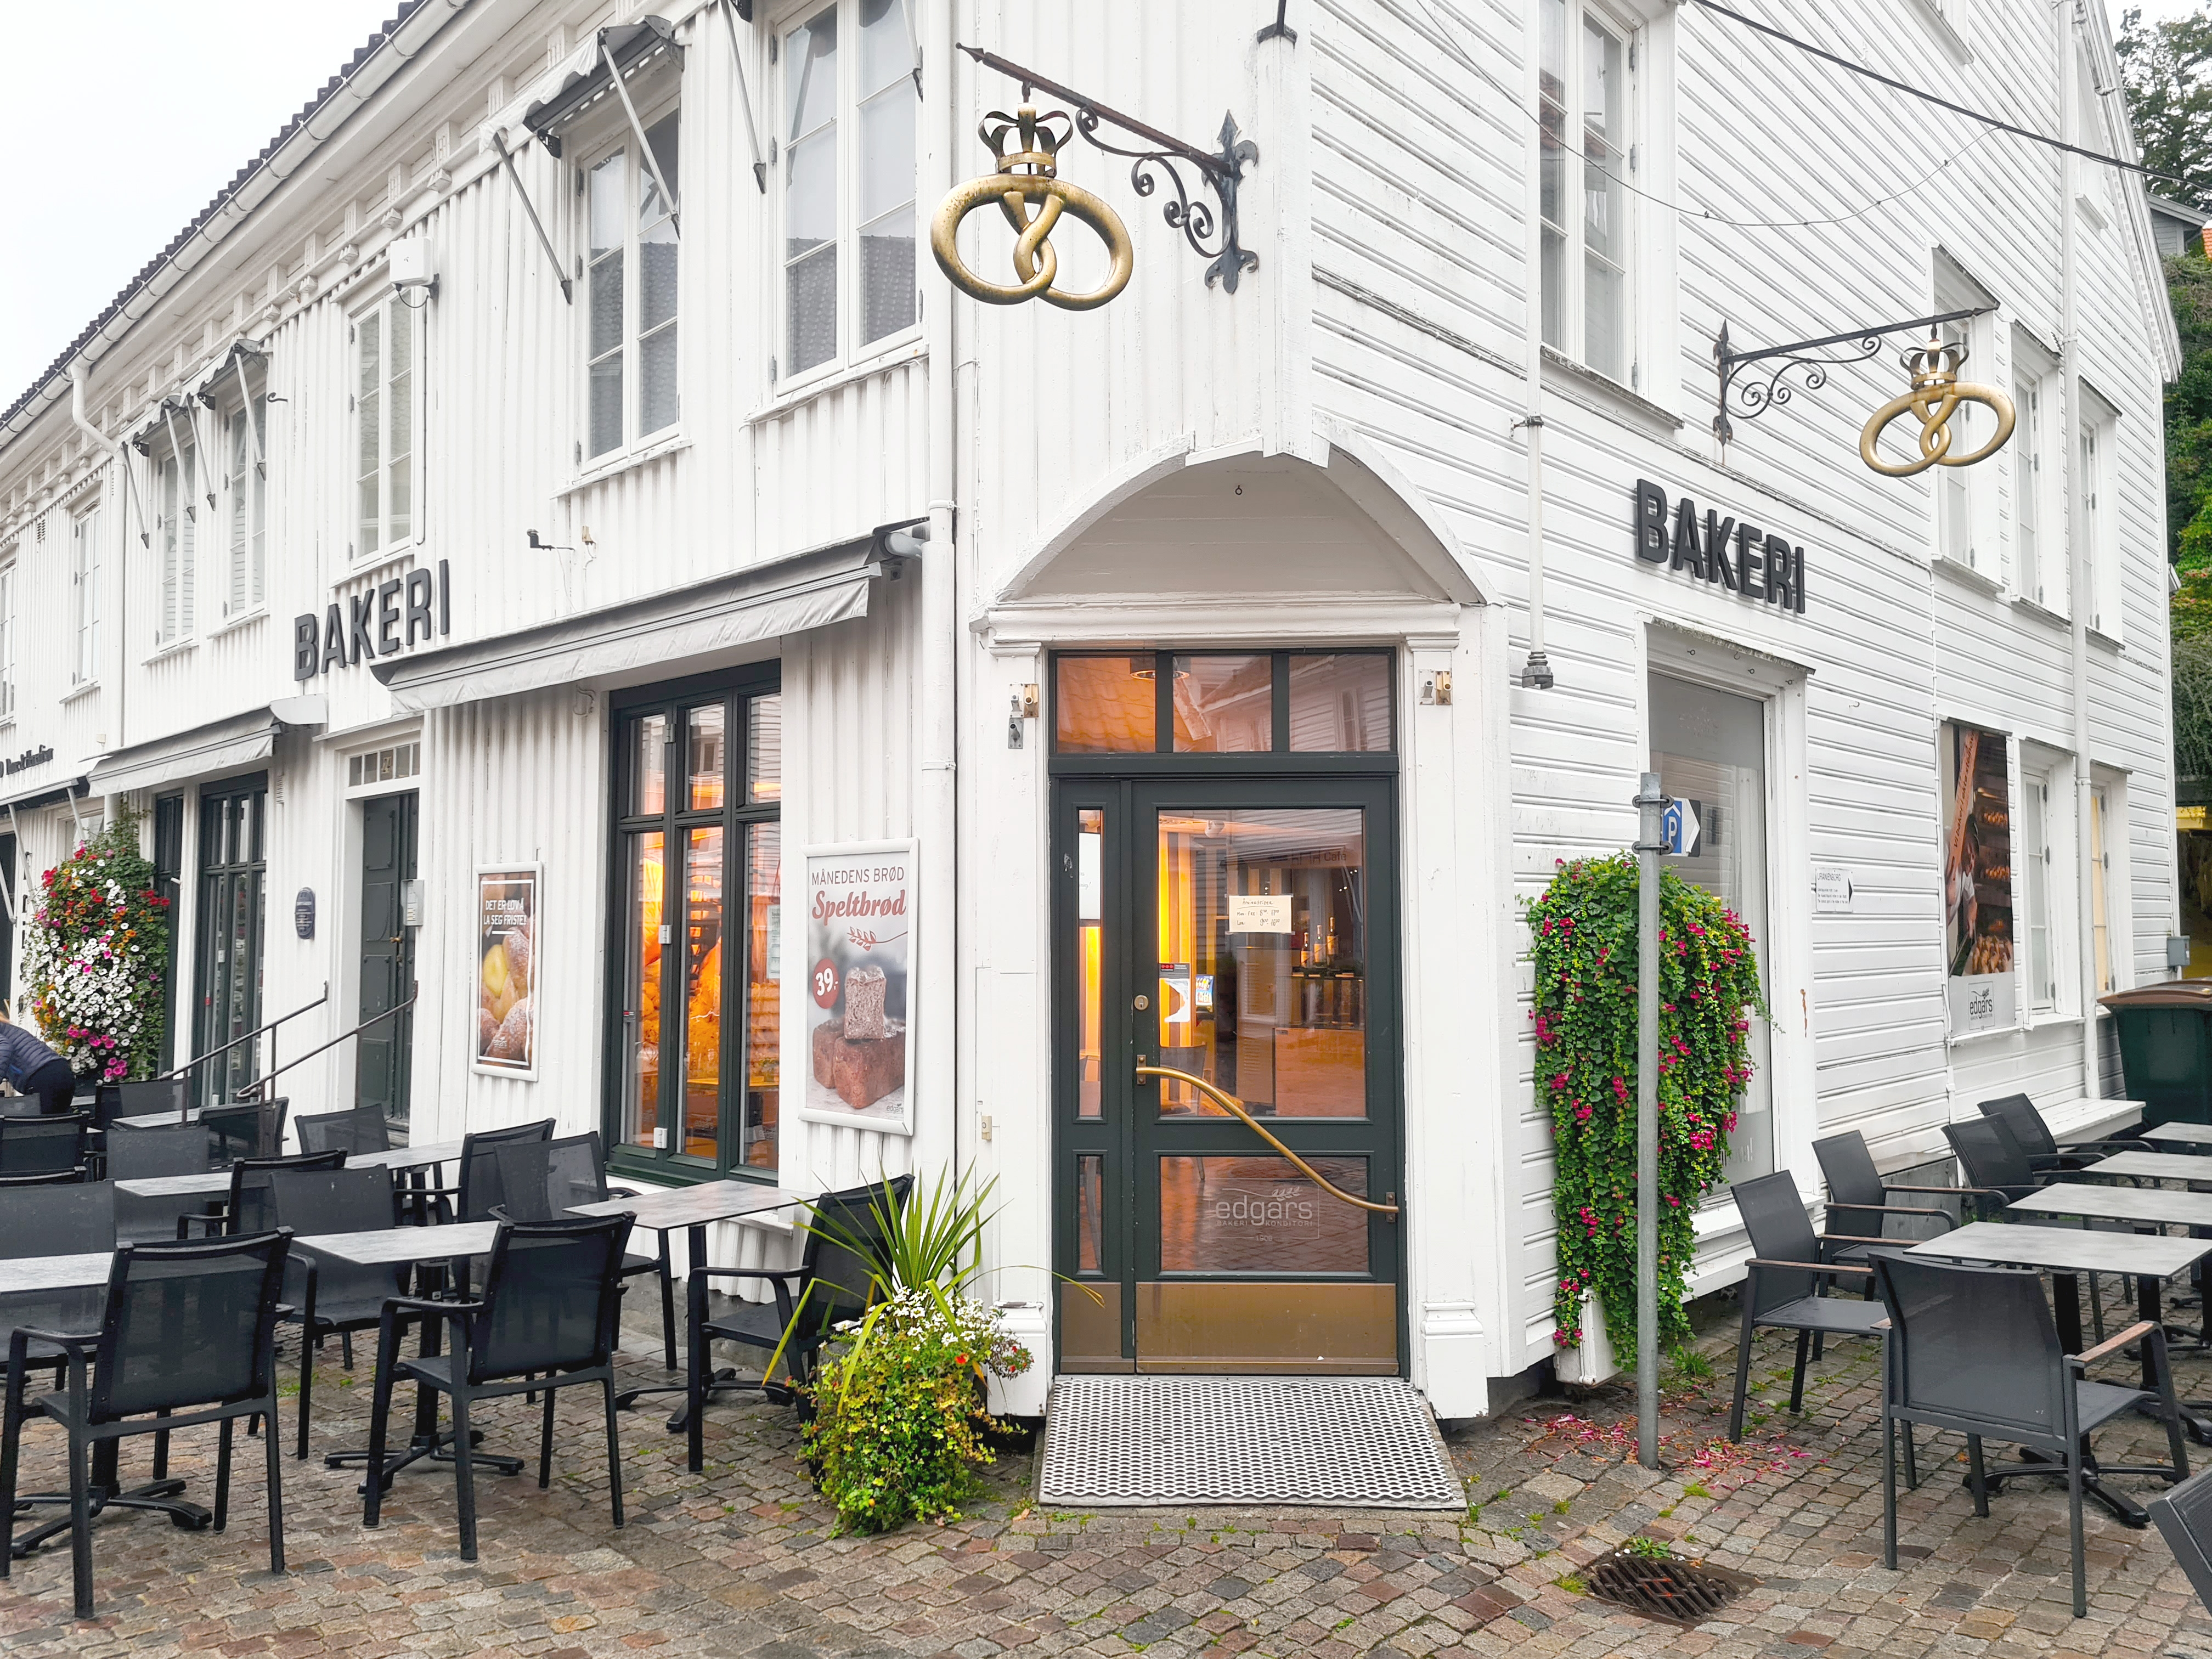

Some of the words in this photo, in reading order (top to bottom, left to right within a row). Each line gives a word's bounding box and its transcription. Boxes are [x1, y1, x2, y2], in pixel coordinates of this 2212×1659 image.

[1637, 478, 1805, 614] BAKERI
[294, 558, 450, 681] BAKERI
[812, 868, 870, 885] MÅNEDENS
[873, 866, 904, 882] BRØD
[485, 900, 497, 910] DET
[497, 900, 506, 910] ER
[812, 889, 906, 926] Speltbrød
[490, 915, 503, 925] SEG
[503, 915, 527, 926] FRISTE!
[815, 968, 839, 996] 39,-
[1970, 995, 1993, 1019] edgars
[1215, 1195, 1313, 1226] edgars
